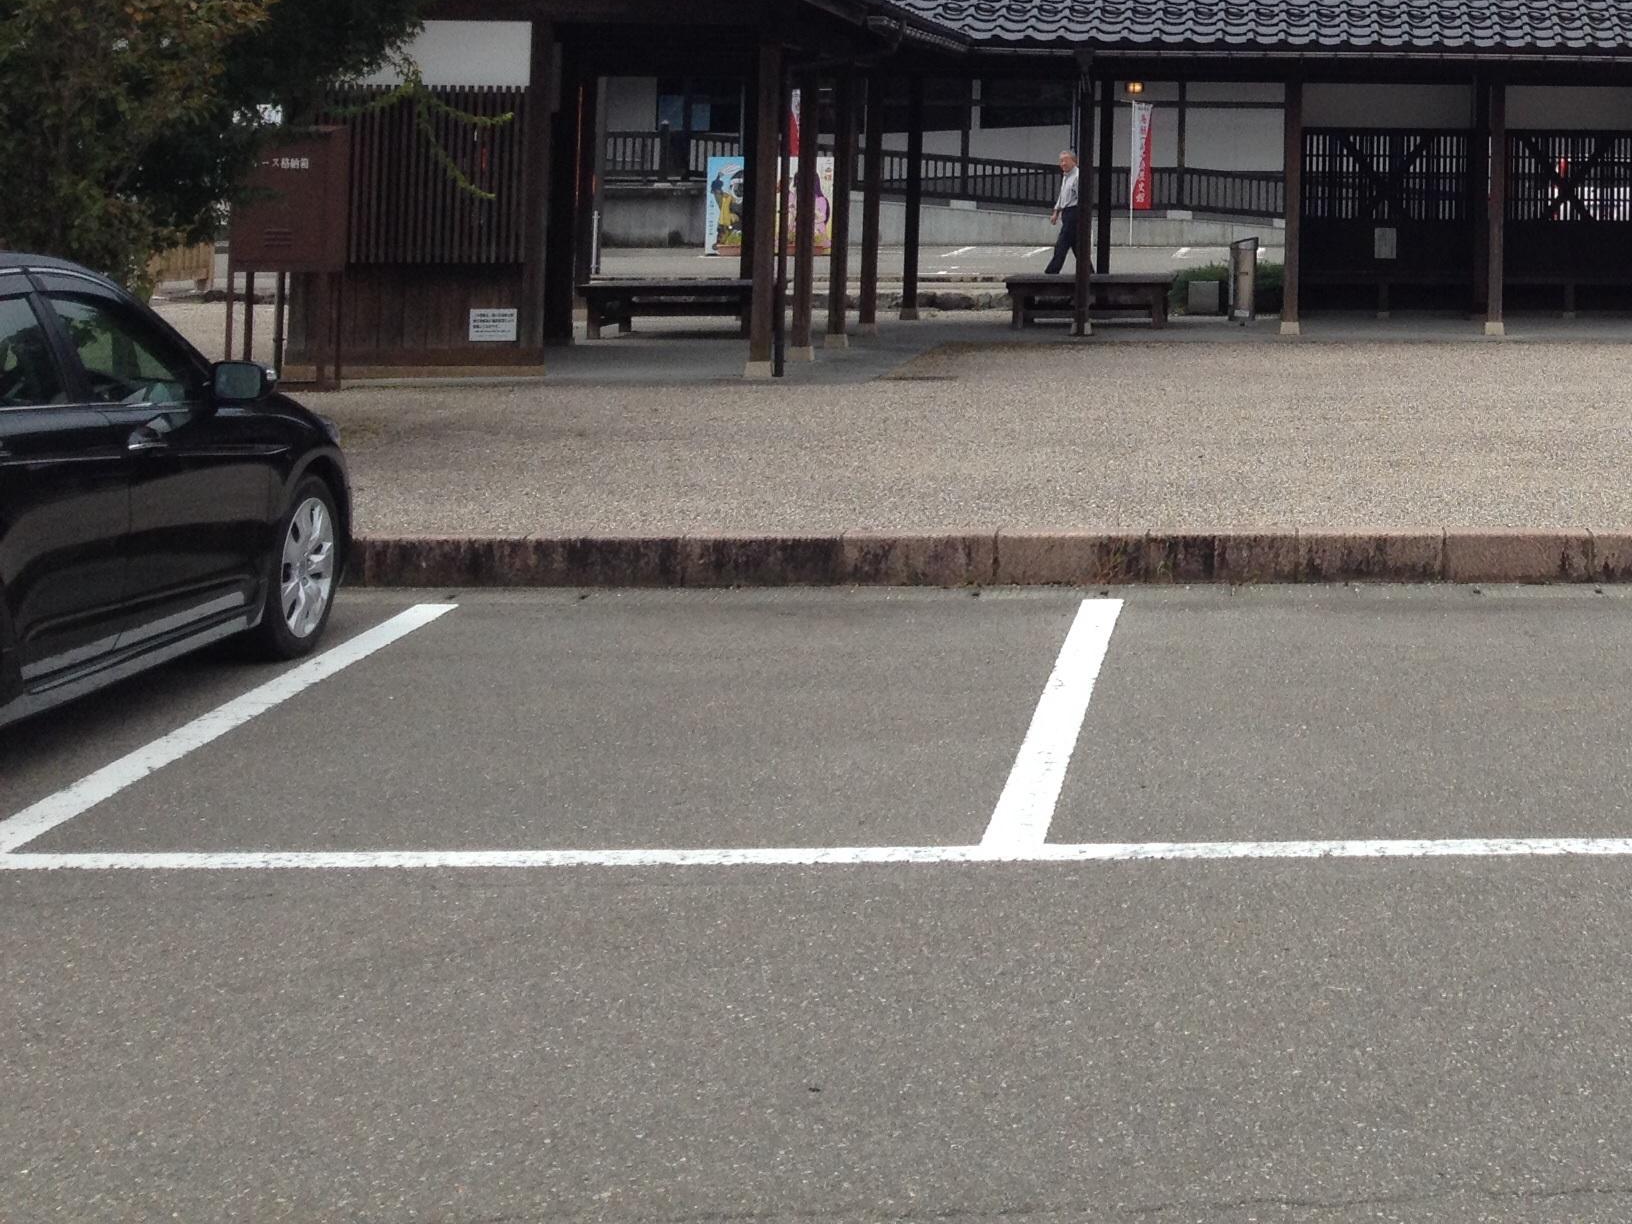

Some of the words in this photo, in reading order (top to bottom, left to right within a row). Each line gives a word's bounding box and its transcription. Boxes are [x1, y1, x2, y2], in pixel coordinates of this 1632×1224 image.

[252, 158, 309, 169] ース格納箱
